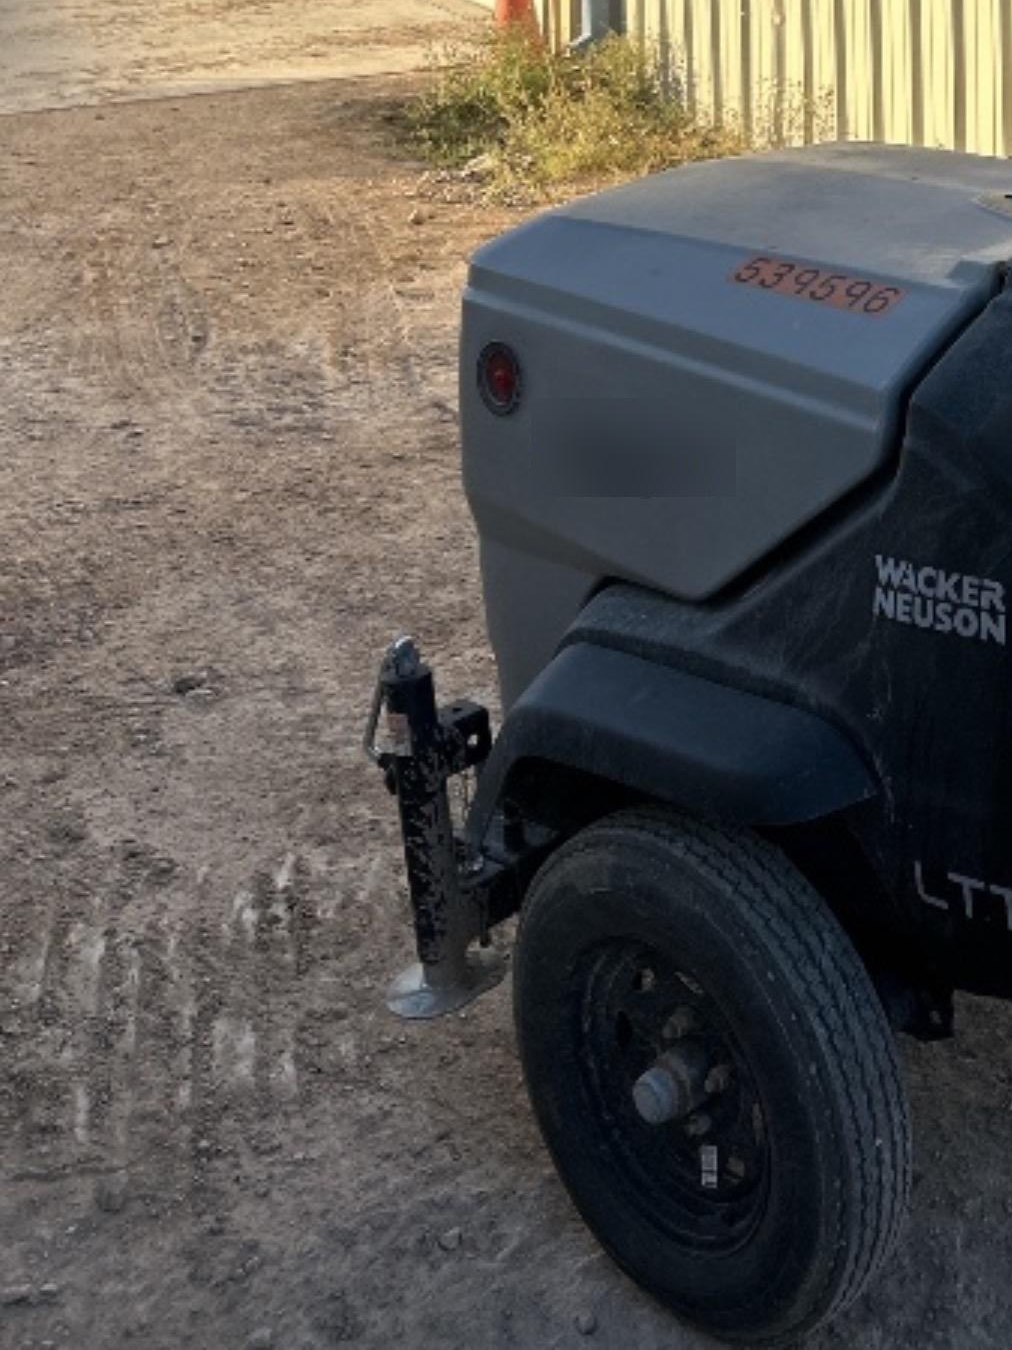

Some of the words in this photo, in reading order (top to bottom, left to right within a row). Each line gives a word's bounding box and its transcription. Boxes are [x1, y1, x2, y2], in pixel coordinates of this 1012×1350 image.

[734, 256, 900, 314] 539596
[875, 554, 1006, 613] WACKER
[873, 586, 1006, 645] NEUSON
